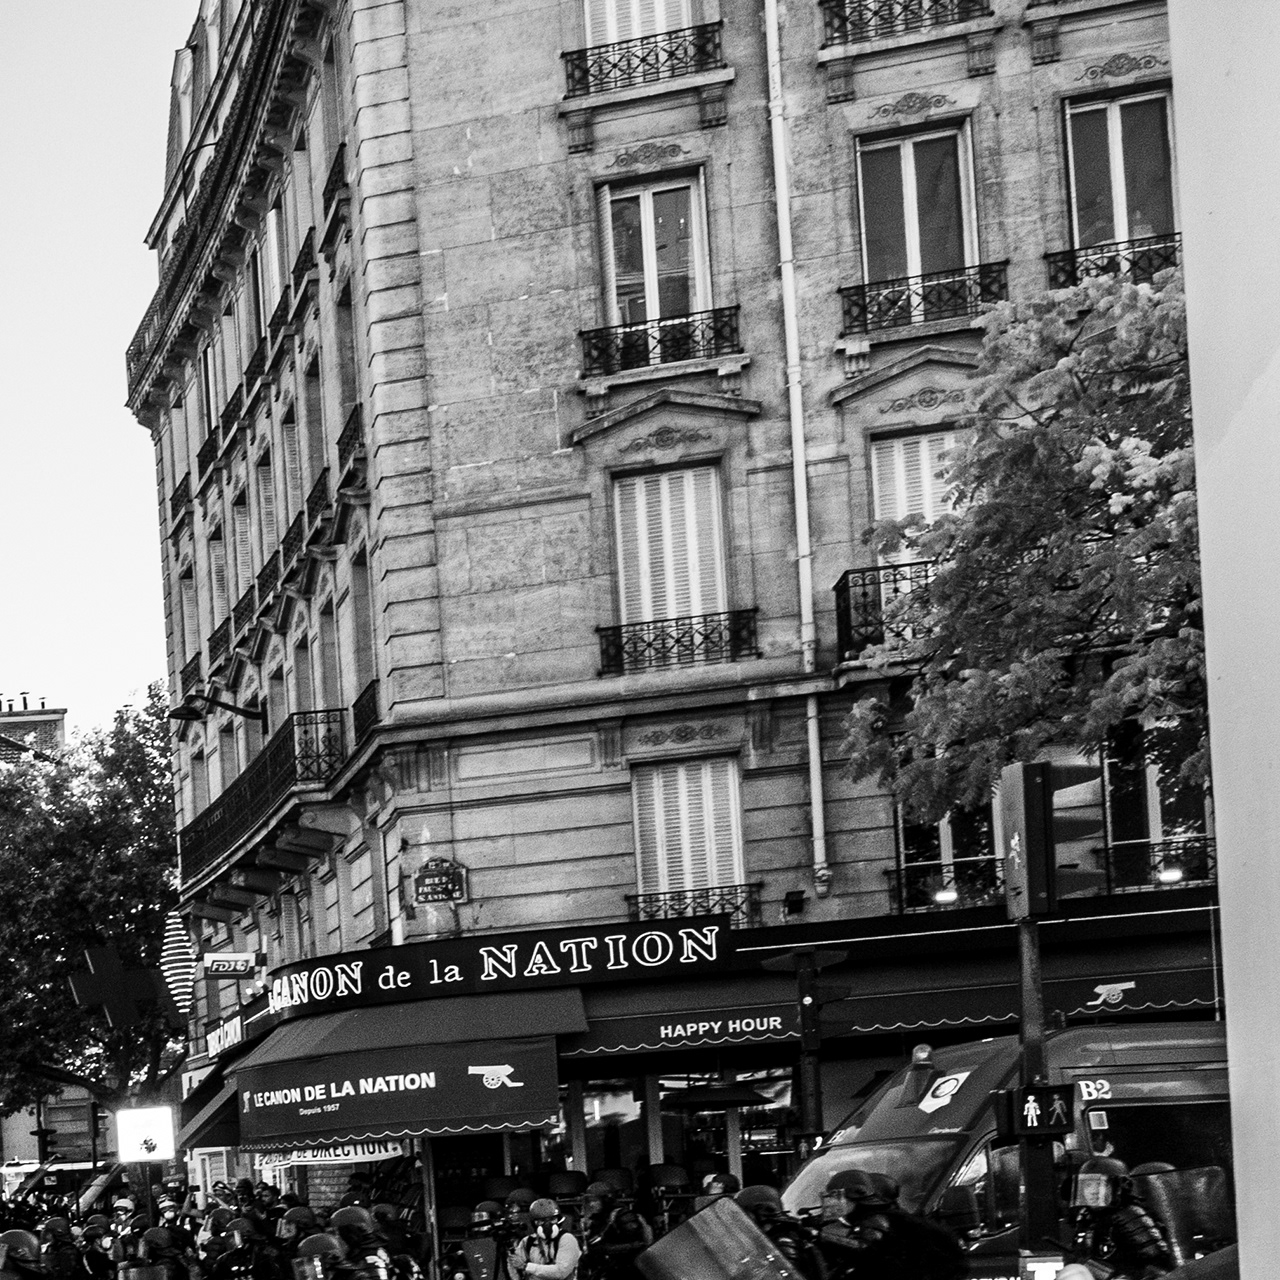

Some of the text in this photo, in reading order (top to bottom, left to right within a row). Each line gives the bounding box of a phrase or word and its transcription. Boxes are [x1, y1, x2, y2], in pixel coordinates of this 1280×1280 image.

[272, 961, 363, 1011] CANON
[378, 966, 412, 990] de
[429, 959, 464, 985] la
[479, 926, 720, 981] NATION
[660, 1016, 782, 1038] HAPPY HOUR
[253, 1071, 437, 1108] LE CANON DE LA NATION
[1077, 1079, 1112, 1101] B2
[299, 1103, 340, 1116] Depuis 1957
